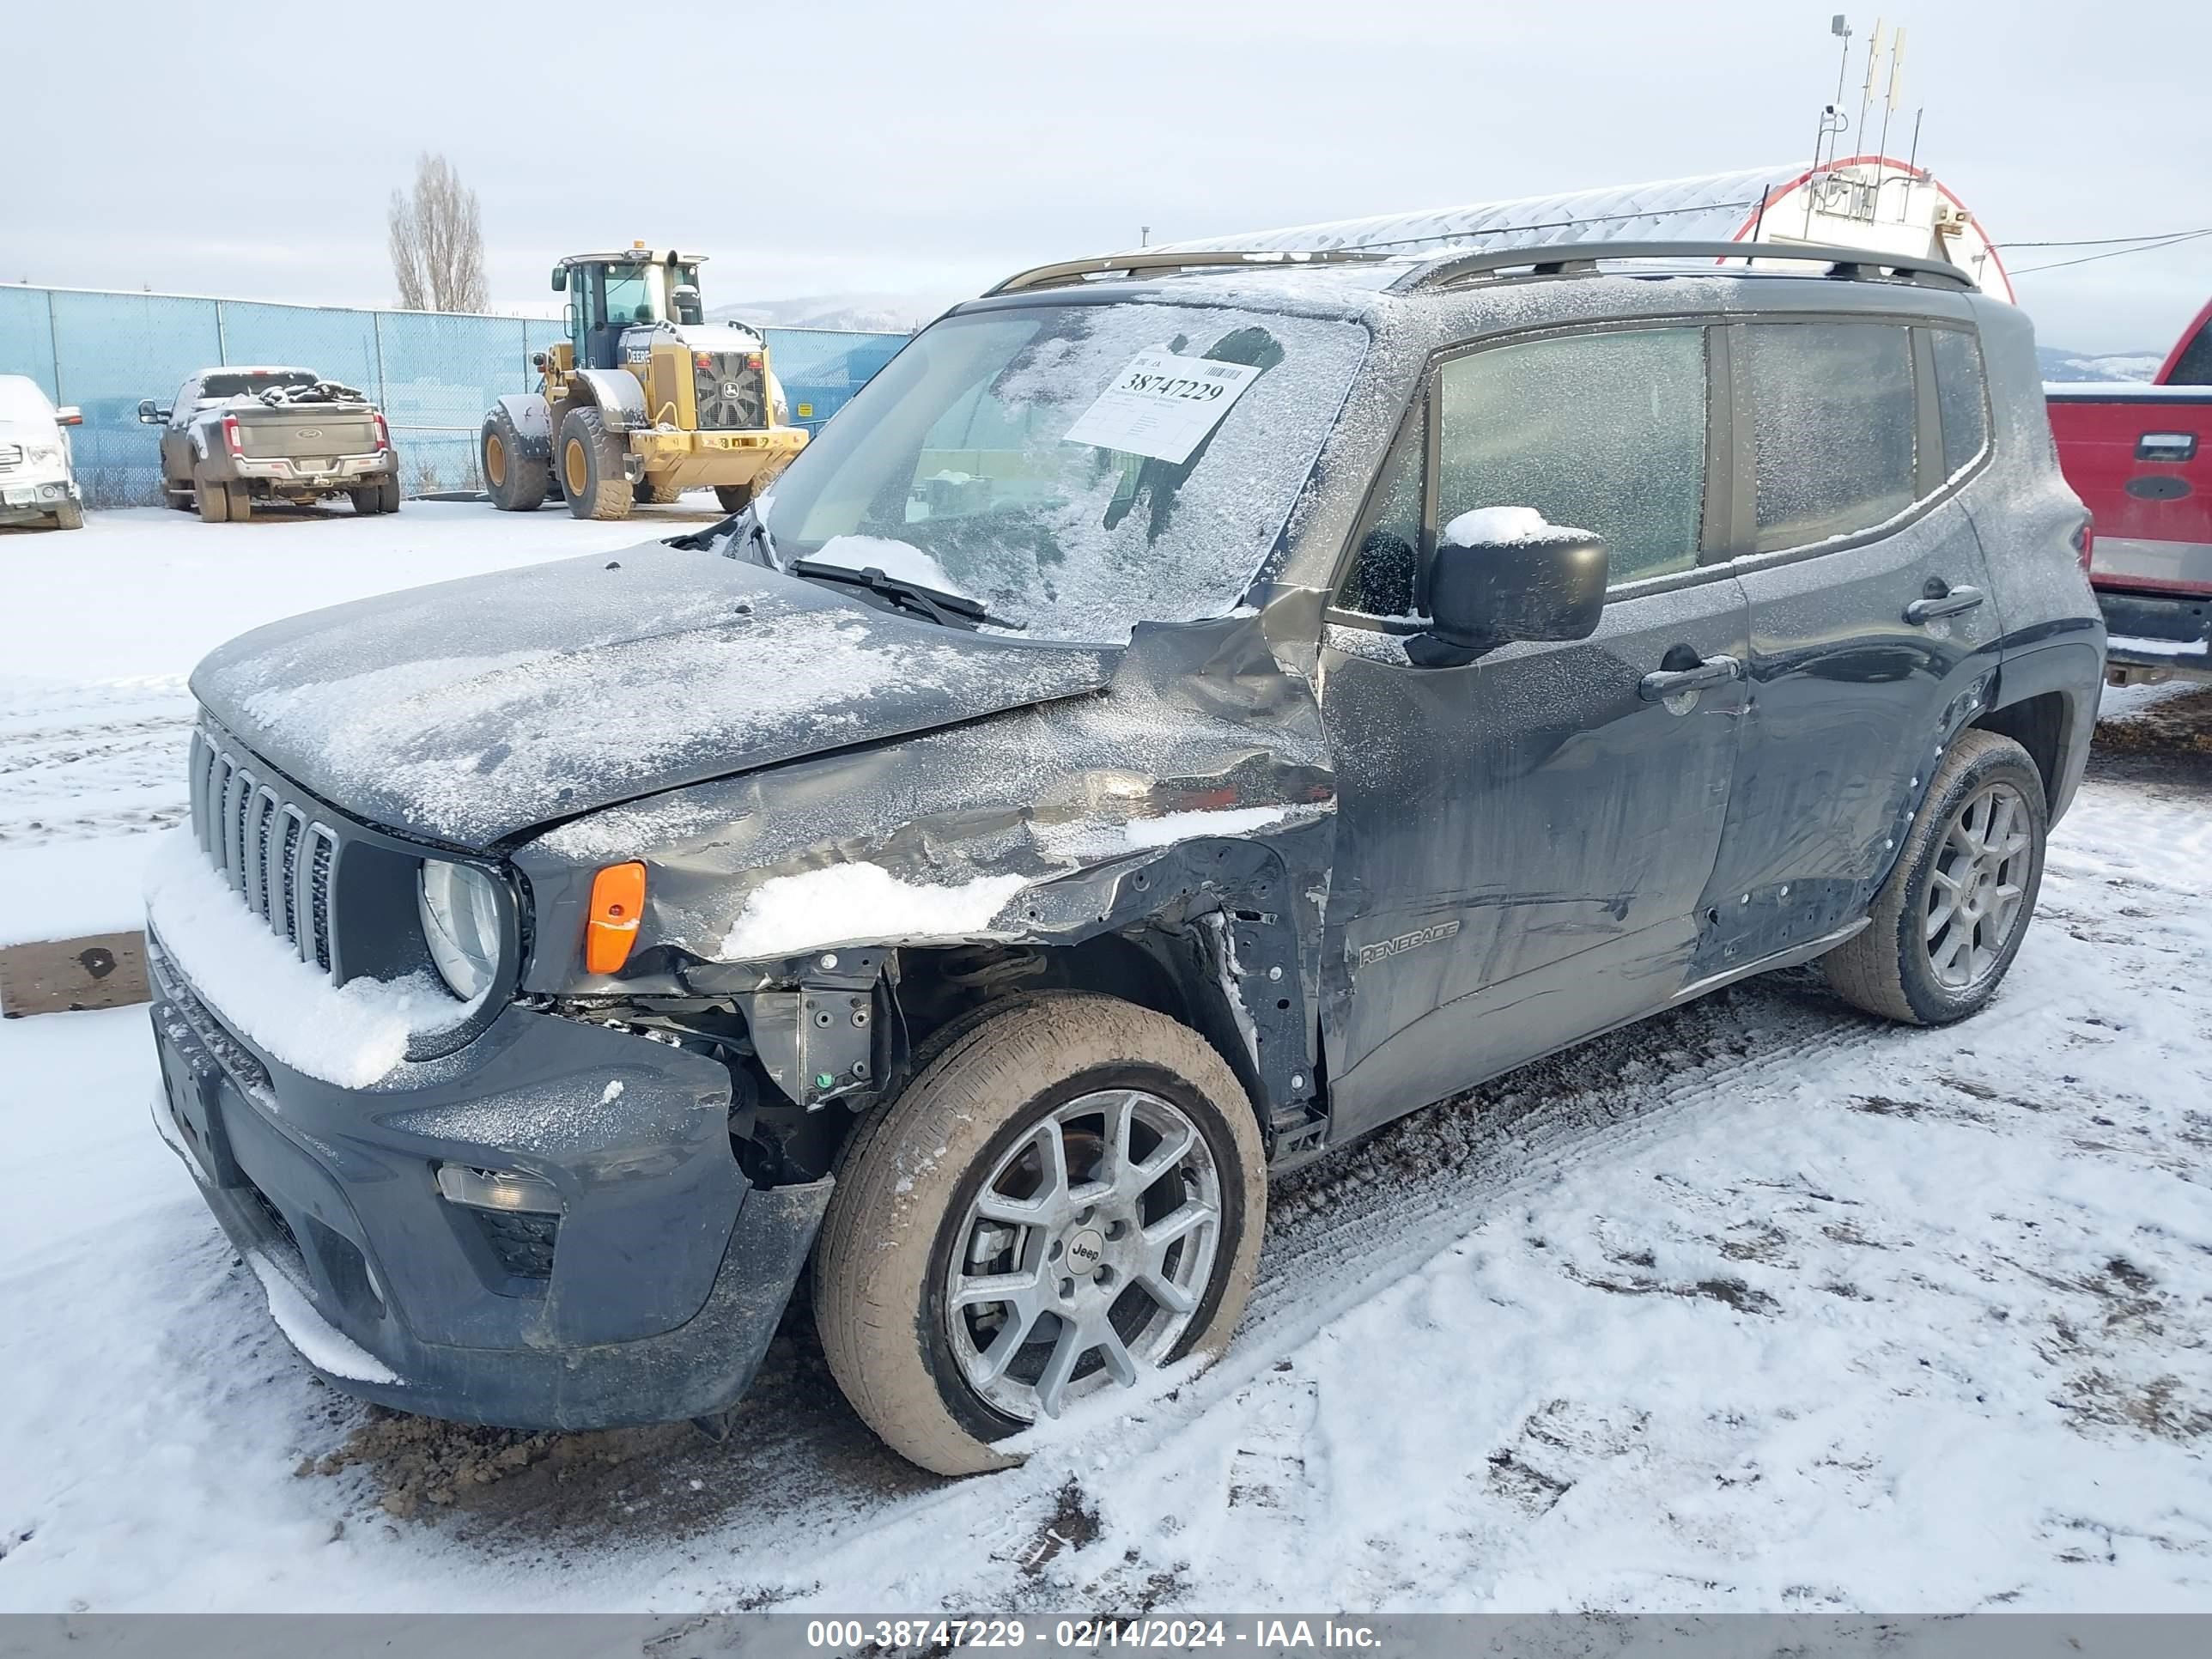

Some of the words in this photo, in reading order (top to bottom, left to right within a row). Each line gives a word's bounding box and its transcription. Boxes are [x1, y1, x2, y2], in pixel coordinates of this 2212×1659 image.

[627, 349, 650, 364] DEERE
[1121, 373, 1224, 402] 38747229
[1359, 921, 1460, 968] RENEGADE
[1072, 1243, 1099, 1261] Jeep
